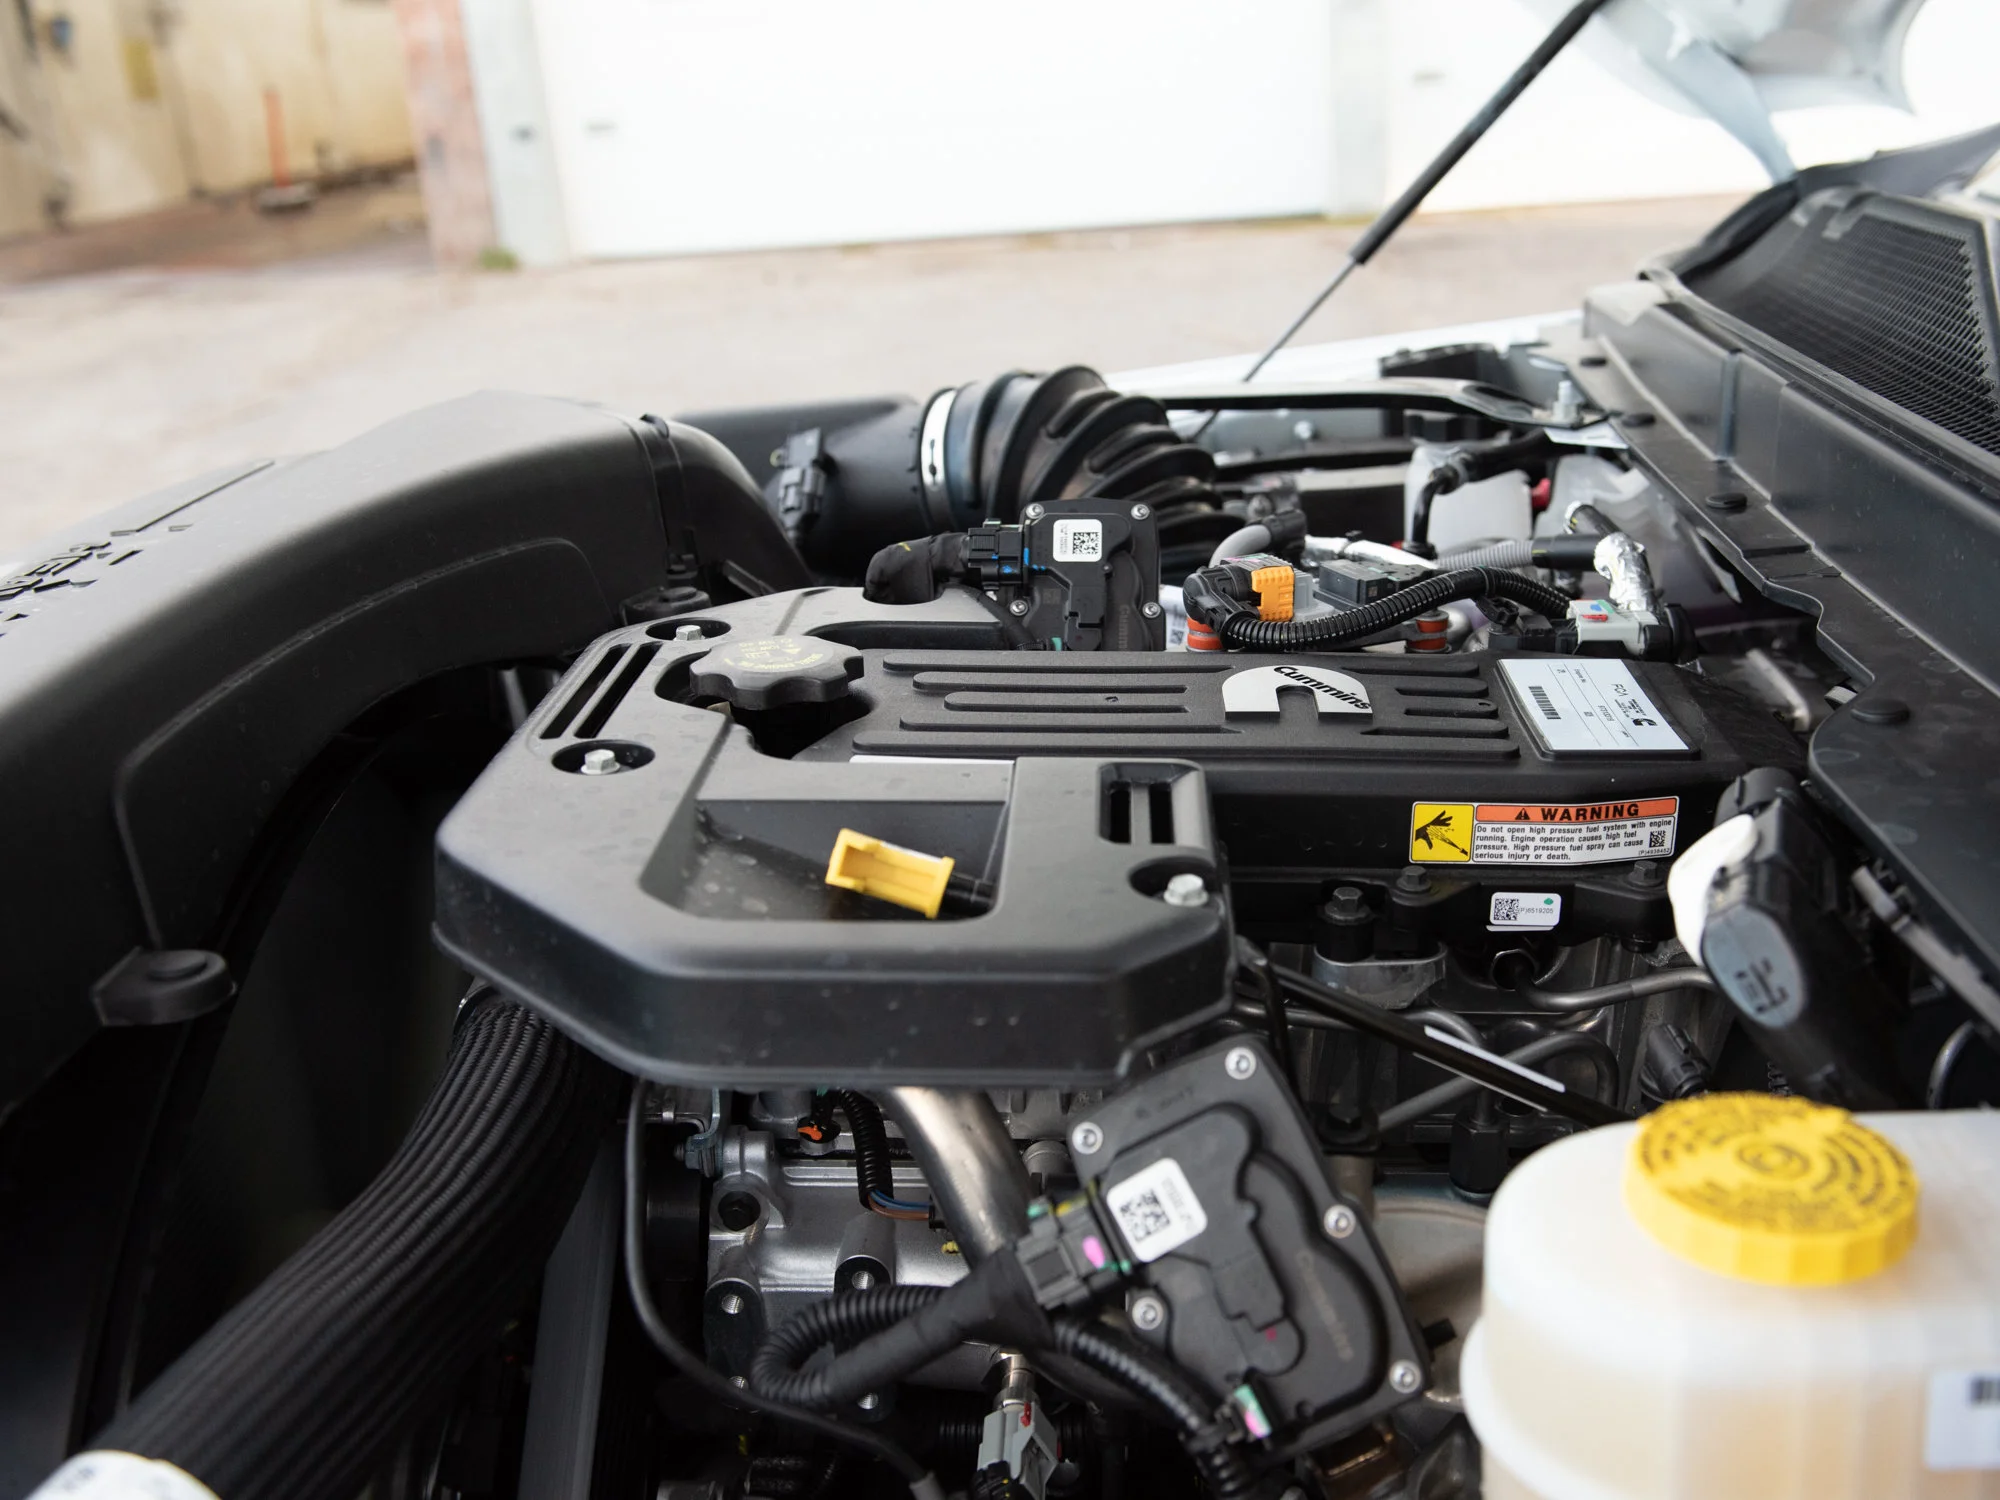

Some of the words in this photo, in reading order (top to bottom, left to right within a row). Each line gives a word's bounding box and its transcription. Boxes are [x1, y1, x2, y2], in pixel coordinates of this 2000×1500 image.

[1274, 666, 1371, 710] Cummins
[1541, 803, 1639, 821] WARNING
[1477, 825, 1487, 833] Do
[1507, 827, 1526, 835] open
[1529, 826, 1546, 835] high
[1549, 827, 1583, 835] pressure
[1602, 823, 1628, 832] system
[1631, 821, 1646, 829] with
[1649, 819, 1672, 828] engine
[1476, 835, 1507, 843] running.
[1510, 835, 1536, 843] Engine
[1539, 835, 1575, 843] operation
[1579, 834, 1602, 842] causes
[1605, 832, 1620, 841] high
[1513, 843, 1530, 851] High
[1586, 843, 1605, 852] spray
[1623, 839, 1644, 847] cause
[1475, 852, 1504, 860] serious
[1507, 852, 1530, 861] injury
